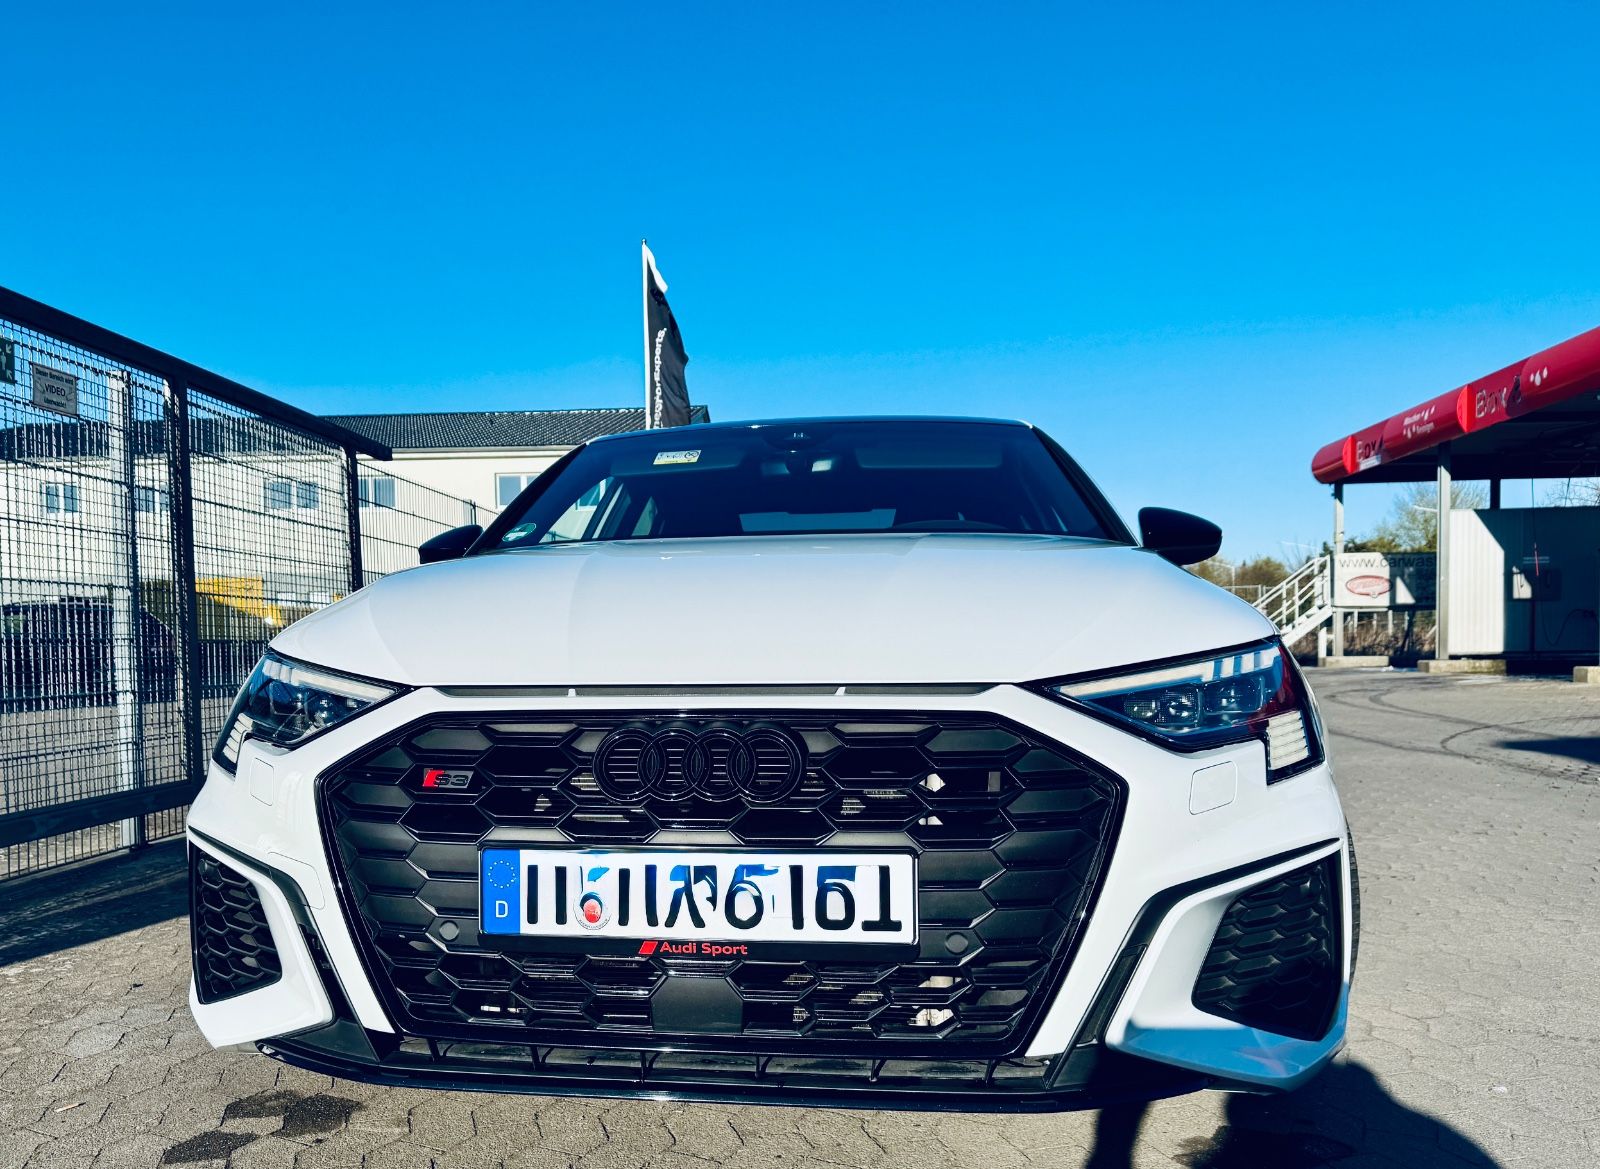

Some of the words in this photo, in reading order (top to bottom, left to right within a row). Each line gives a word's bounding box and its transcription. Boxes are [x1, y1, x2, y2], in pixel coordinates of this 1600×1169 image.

[44, 383, 66, 397] VIDEO
[1340, 555, 1436, 568] www.carwas
[433, 773, 470, 787] S3
[495, 900, 509, 918] D
[659, 941, 697, 954] Audi
[701, 942, 748, 956] Sport
